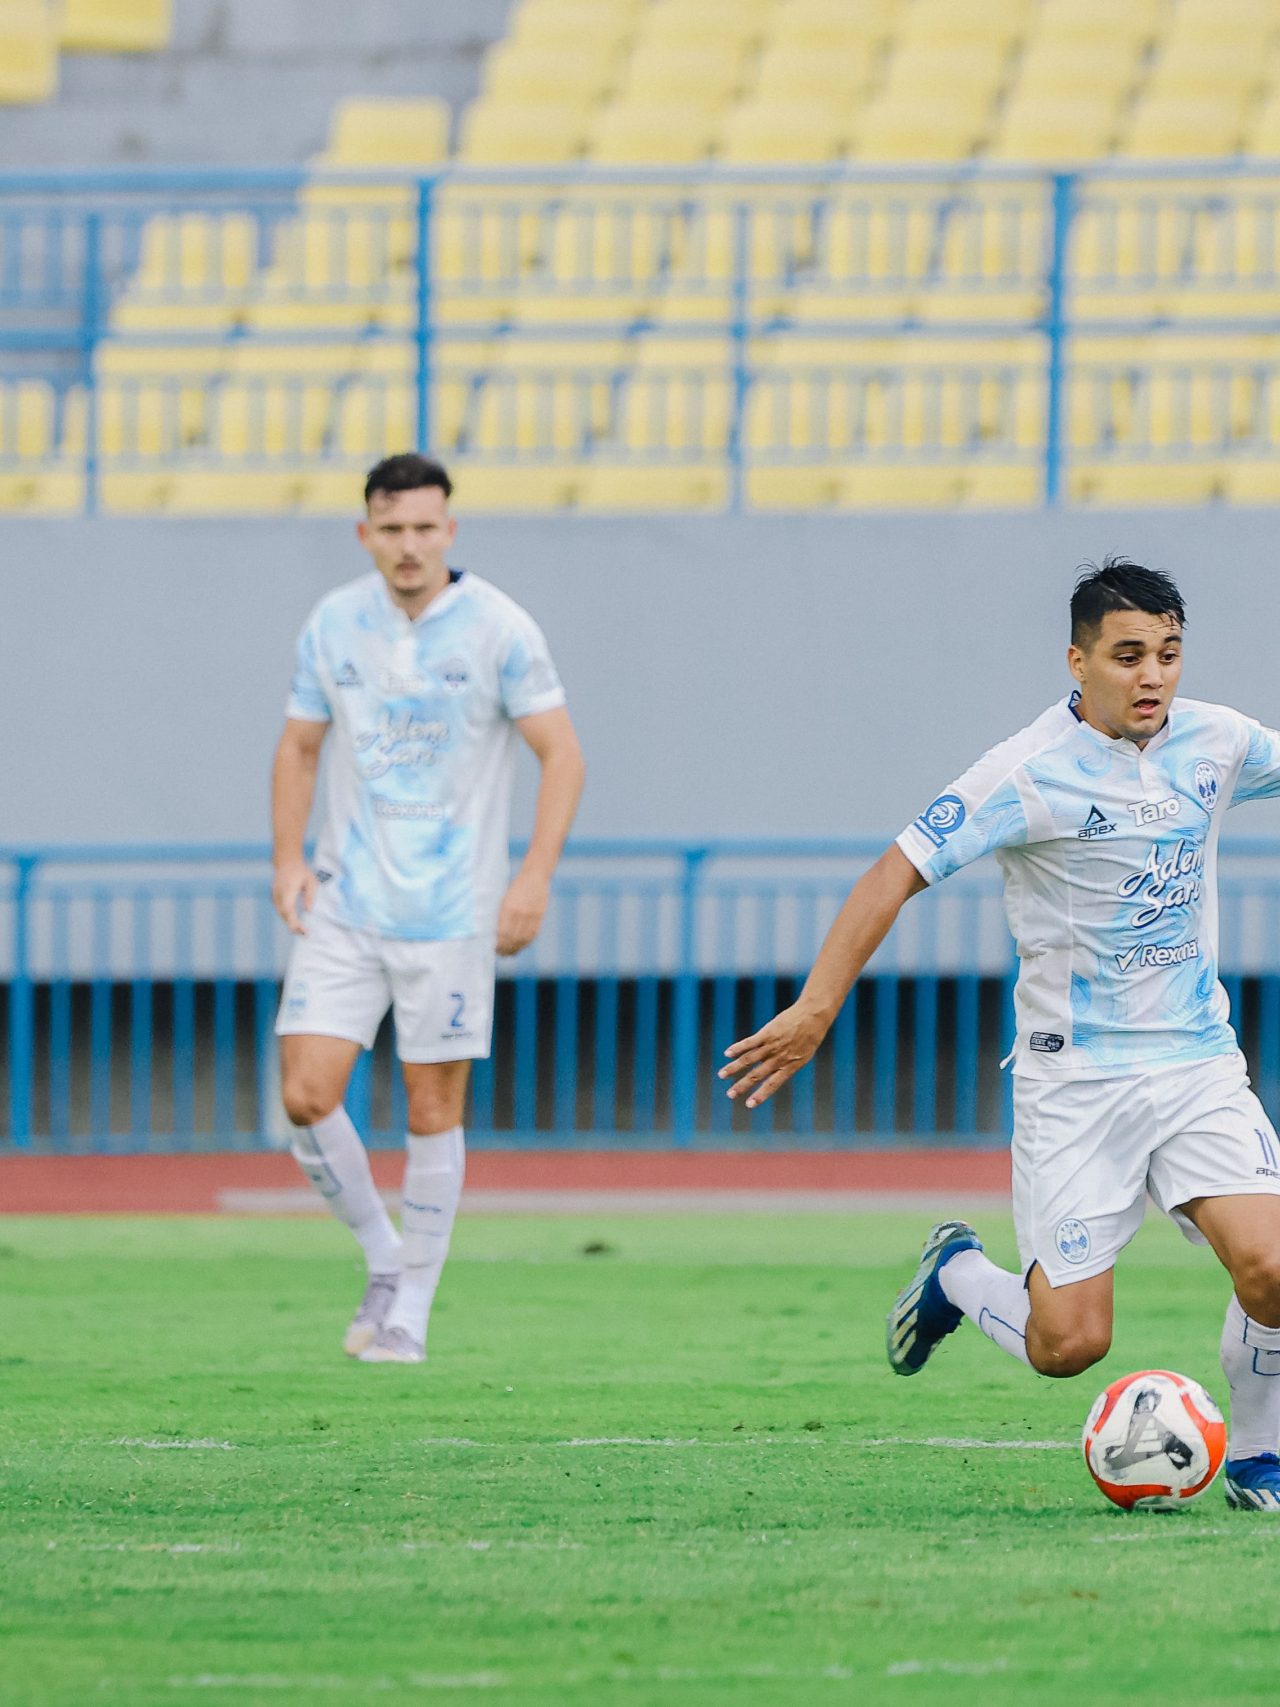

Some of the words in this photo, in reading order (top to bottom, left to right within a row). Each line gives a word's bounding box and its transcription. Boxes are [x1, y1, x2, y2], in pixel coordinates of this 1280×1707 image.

[1127, 797, 1181, 828] Taro
[1077, 822, 1118, 839] apex
[450, 991, 465, 1028] 2
[1253, 1128, 1278, 1169] 11
